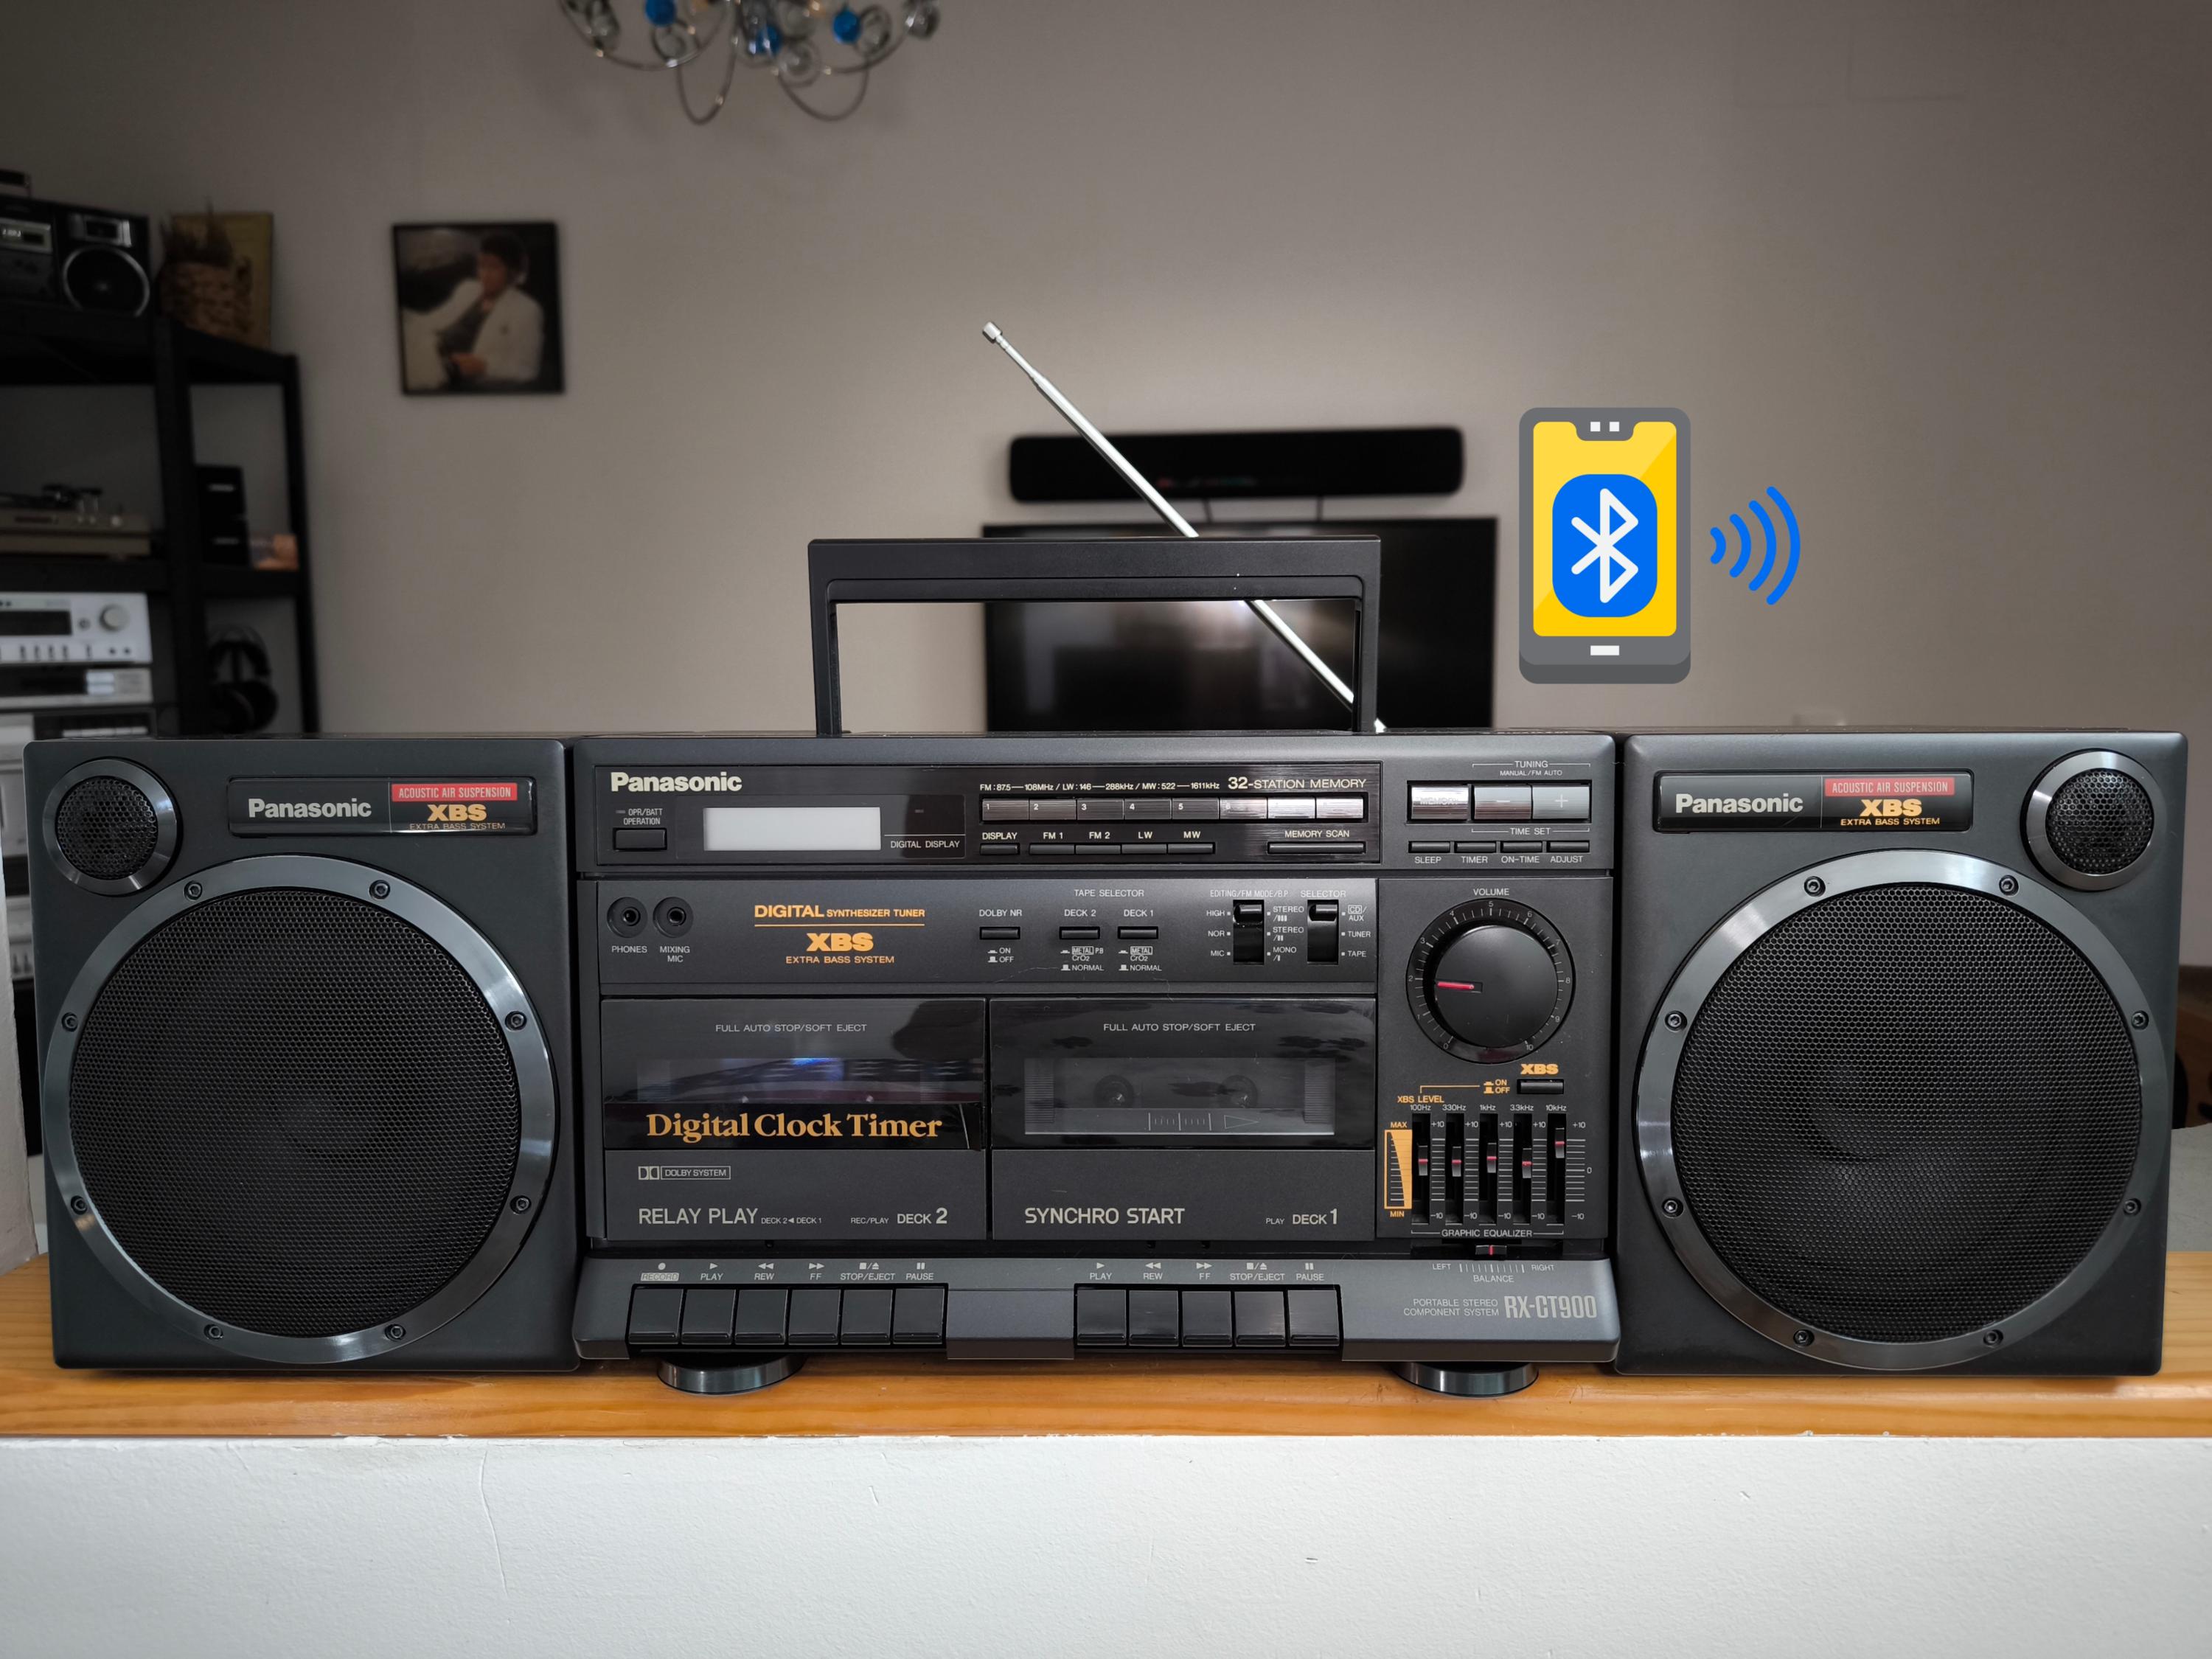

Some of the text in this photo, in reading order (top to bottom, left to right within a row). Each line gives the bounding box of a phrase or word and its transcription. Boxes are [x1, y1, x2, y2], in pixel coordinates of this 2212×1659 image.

[1514, 760, 1548, 768] TUNING
[611, 772, 742, 792] Panasonic
[1228, 776, 1366, 789] 32-STATION MEMORY
[1832, 782, 1948, 793] ACOUSTIC AIR SUSPENSION
[399, 787, 511, 799] ACOUSTIC AIR SUSPENSION
[248, 798, 372, 818] Panasonic
[1676, 793, 1803, 813] Panasonic
[1860, 799, 1922, 816] XBS
[427, 804, 487, 821] XBS
[628, 808, 663, 816] OPR/BATT
[1099, 889, 1144, 897] SELECTOR
[754, 905, 925, 918] DIGITAL SYNTHESIZER TUNER
[806, 933, 874, 952] XBS
[1104, 1023, 1128, 1032] FULL
[1520, 1064, 1559, 1074] XBS
[646, 1113, 943, 1144] Digital Clock Timer
[665, 1169, 726, 1177] DOLBY SYSTEM
[639, 1208, 701, 1225] RELAY
[709, 1208, 758, 1224] PLAY
[897, 1213, 931, 1224] DECK
[936, 1207, 947, 1224] 2
[1025, 1208, 1185, 1224] SYNCHRO START
[1293, 1214, 1326, 1224] DECK
[1330, 1208, 1338, 1224] 1
[641, 1273, 678, 1281] RECORD
[1473, 1275, 1514, 1283] BALANCE
[1413, 1298, 1498, 1307] PORTABLE STEREO
[1503, 1295, 1597, 1318] RX-CT900
[1403, 1308, 1500, 1316] COMPONENT SYSTEM
